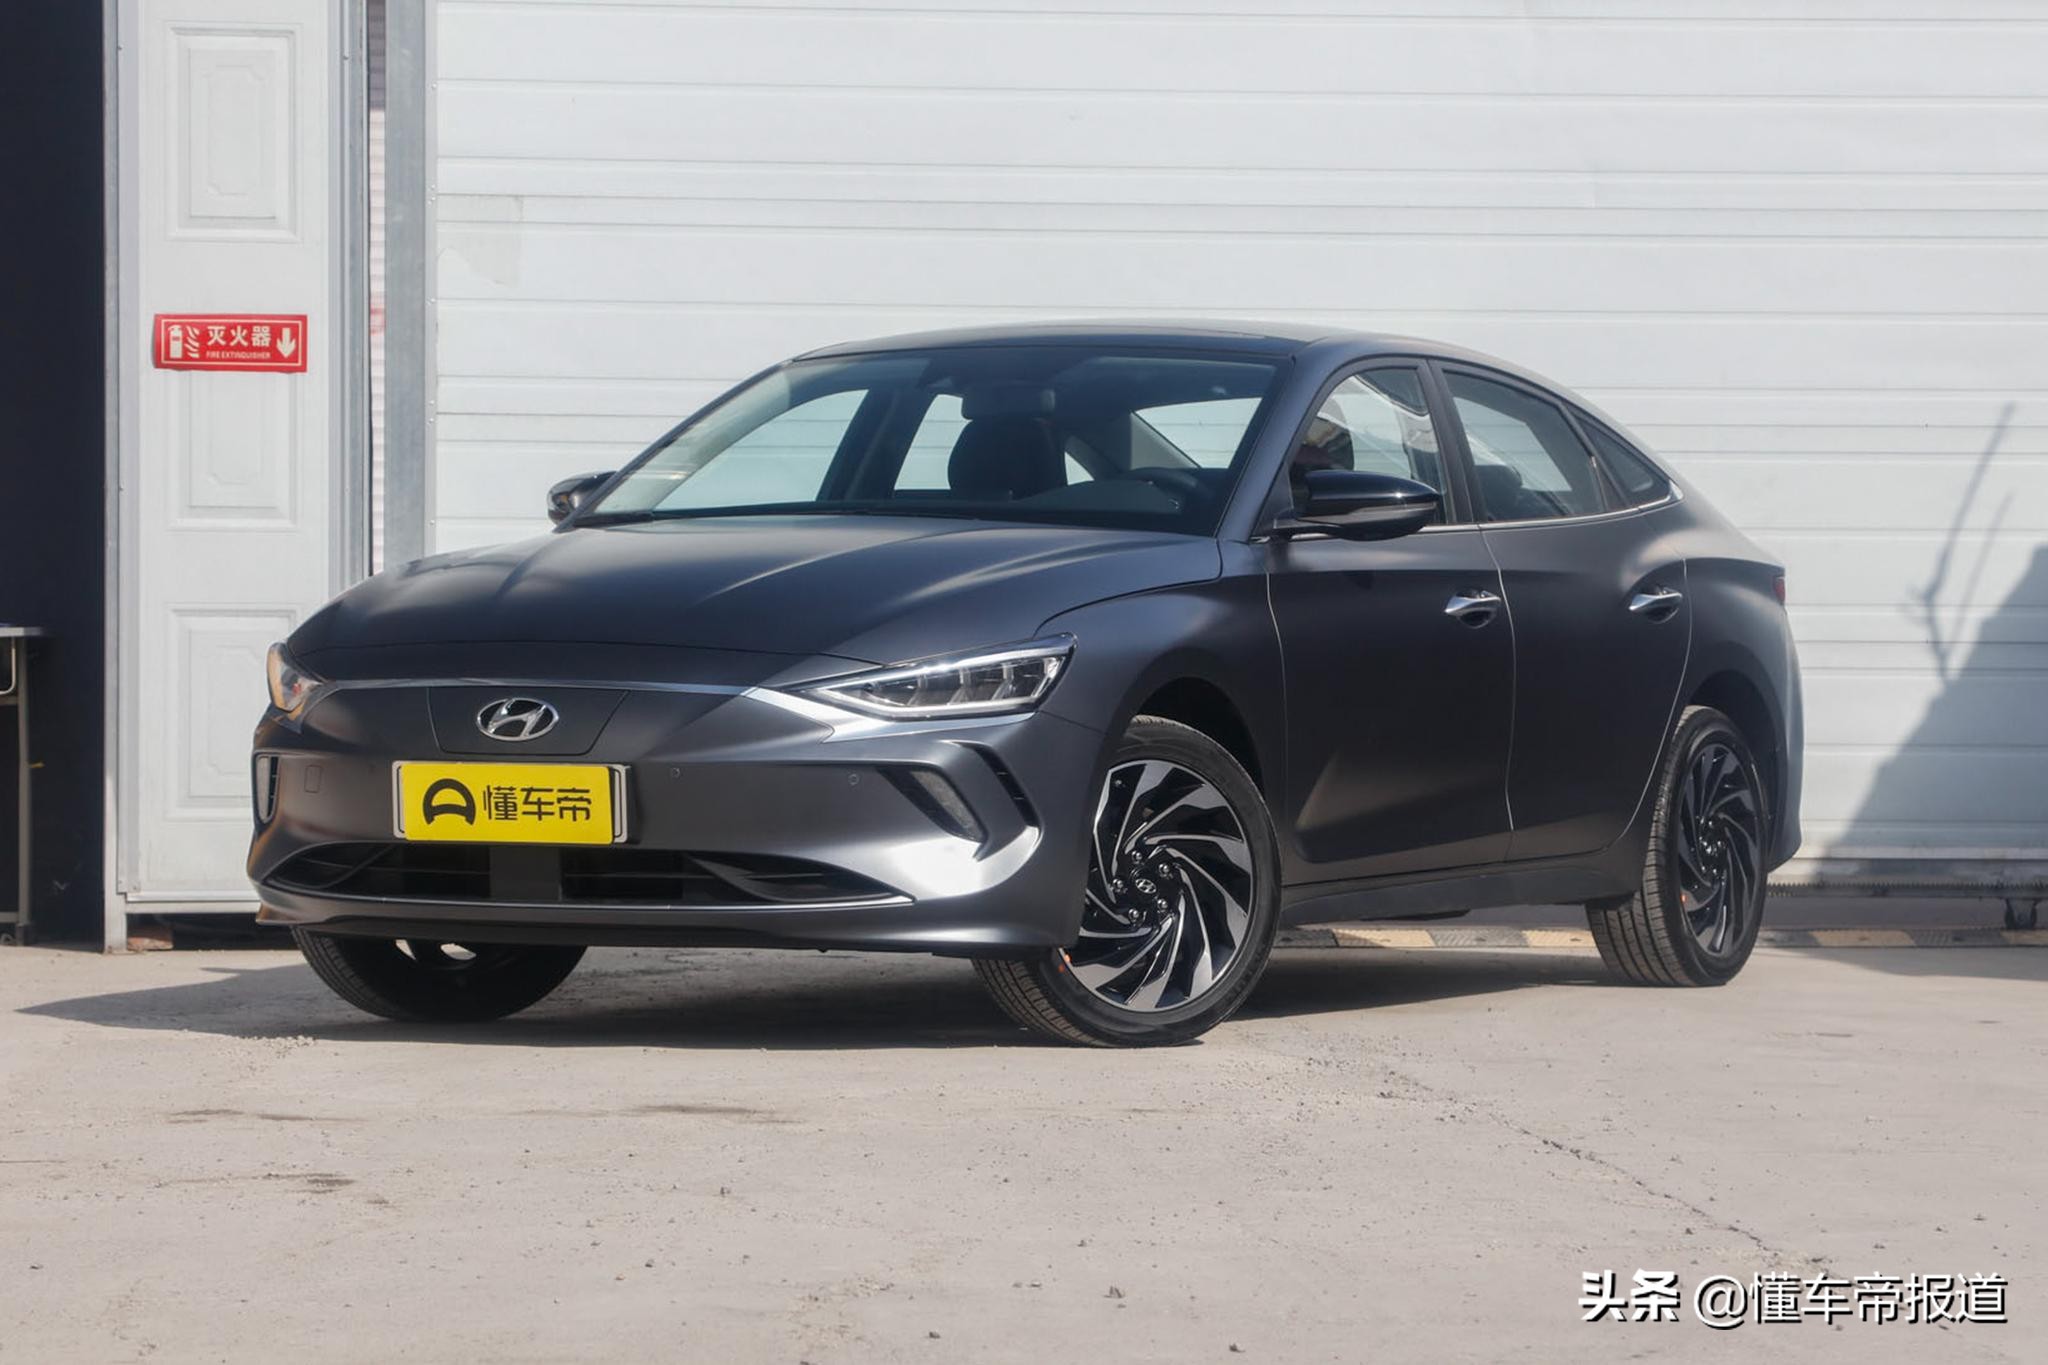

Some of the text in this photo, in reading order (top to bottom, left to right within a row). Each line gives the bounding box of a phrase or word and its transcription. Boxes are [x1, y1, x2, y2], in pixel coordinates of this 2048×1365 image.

[207, 325, 271, 347] 灭火器
[206, 351, 271, 359] FIRE EXTINGUISHER
[483, 785, 592, 822] 懂车帝
